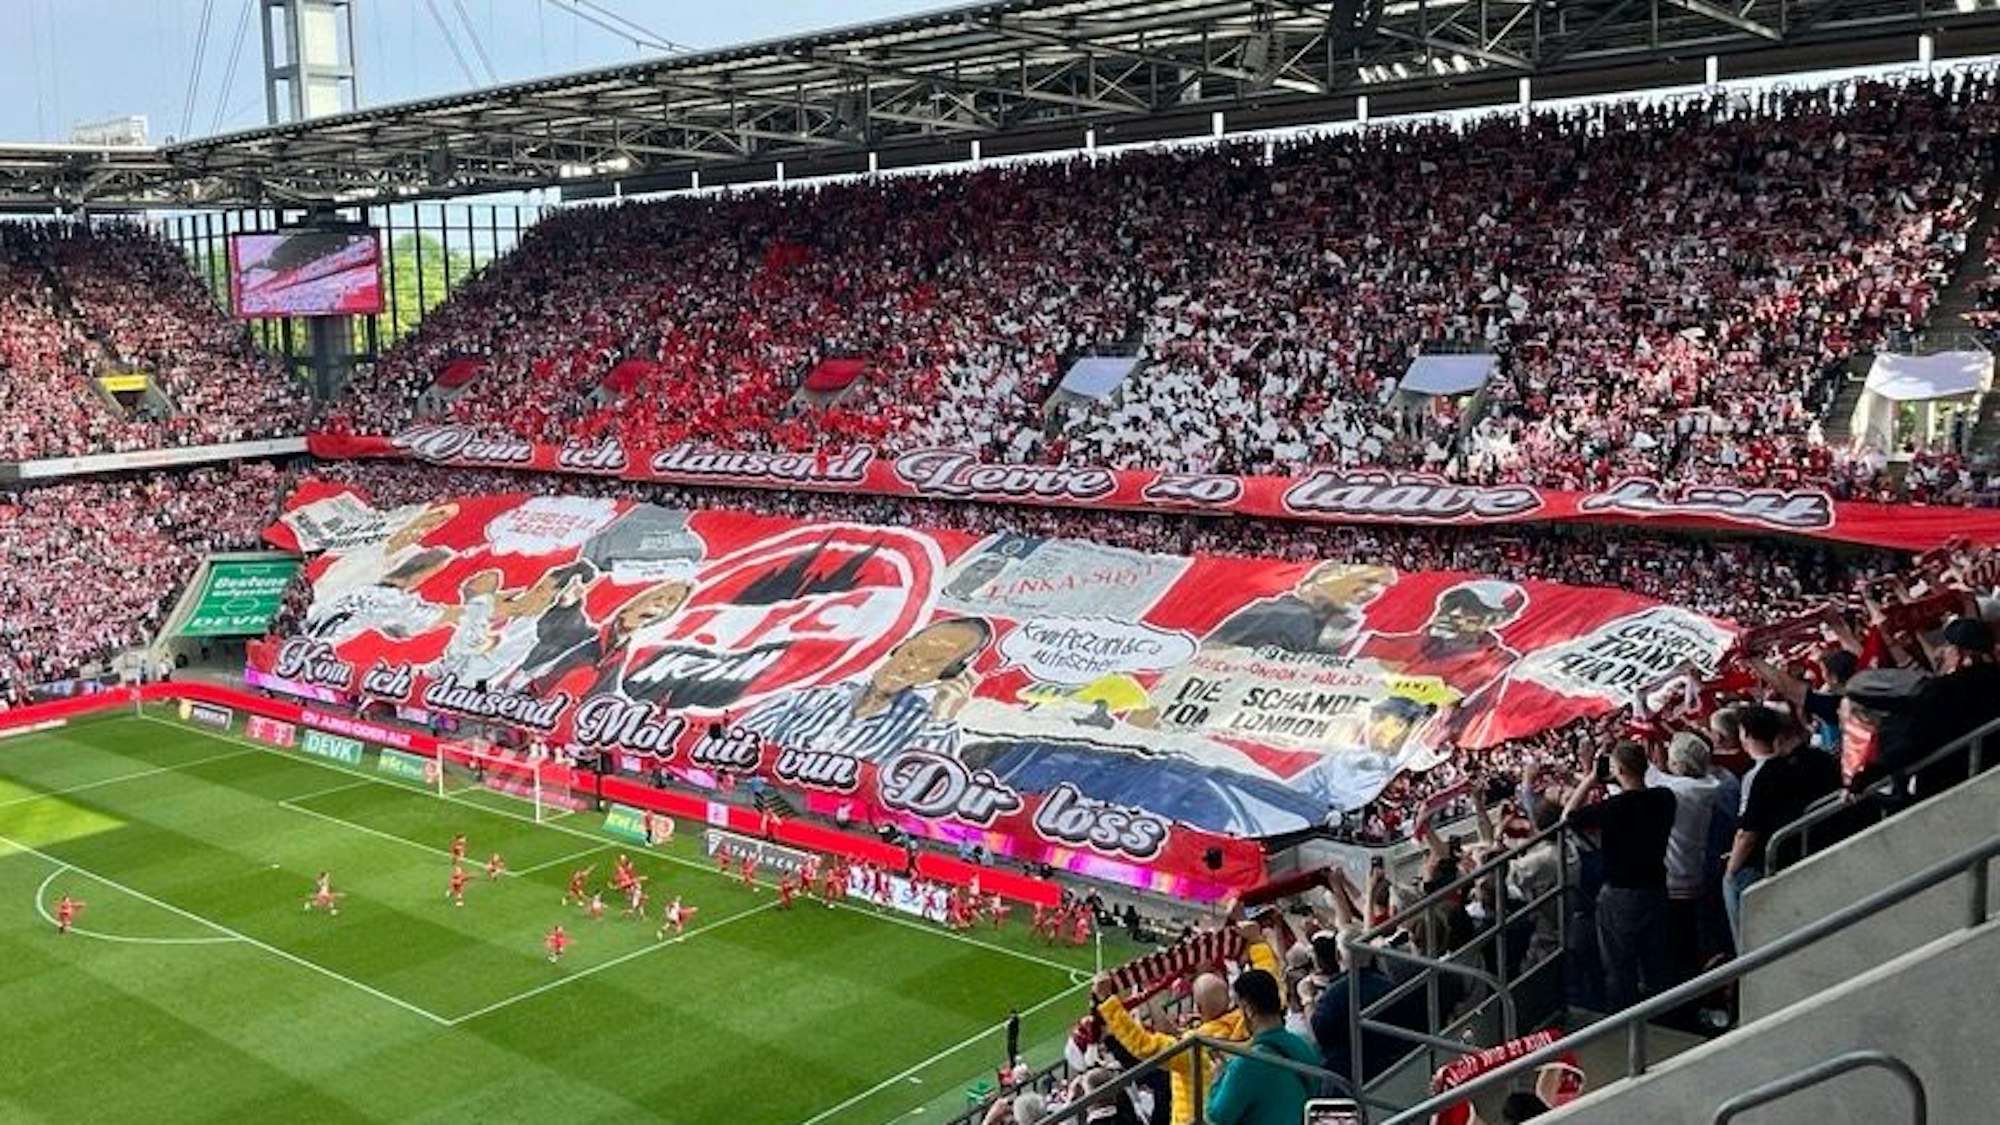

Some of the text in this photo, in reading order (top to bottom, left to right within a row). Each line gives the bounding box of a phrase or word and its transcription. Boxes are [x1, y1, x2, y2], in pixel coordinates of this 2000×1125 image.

[393, 427, 533, 460] Wenn
[560, 440, 627, 469] ich
[900, 450, 1112, 498] Levve
[308, 733, 352, 762] DEVK
[361, 659, 412, 699] ich
[426, 673, 569, 731] dausend
[575, 696, 686, 758] Mol
[778, 747, 858, 788] vun
[881, 750, 1020, 826] Dir
[1037, 781, 1167, 858] loss
